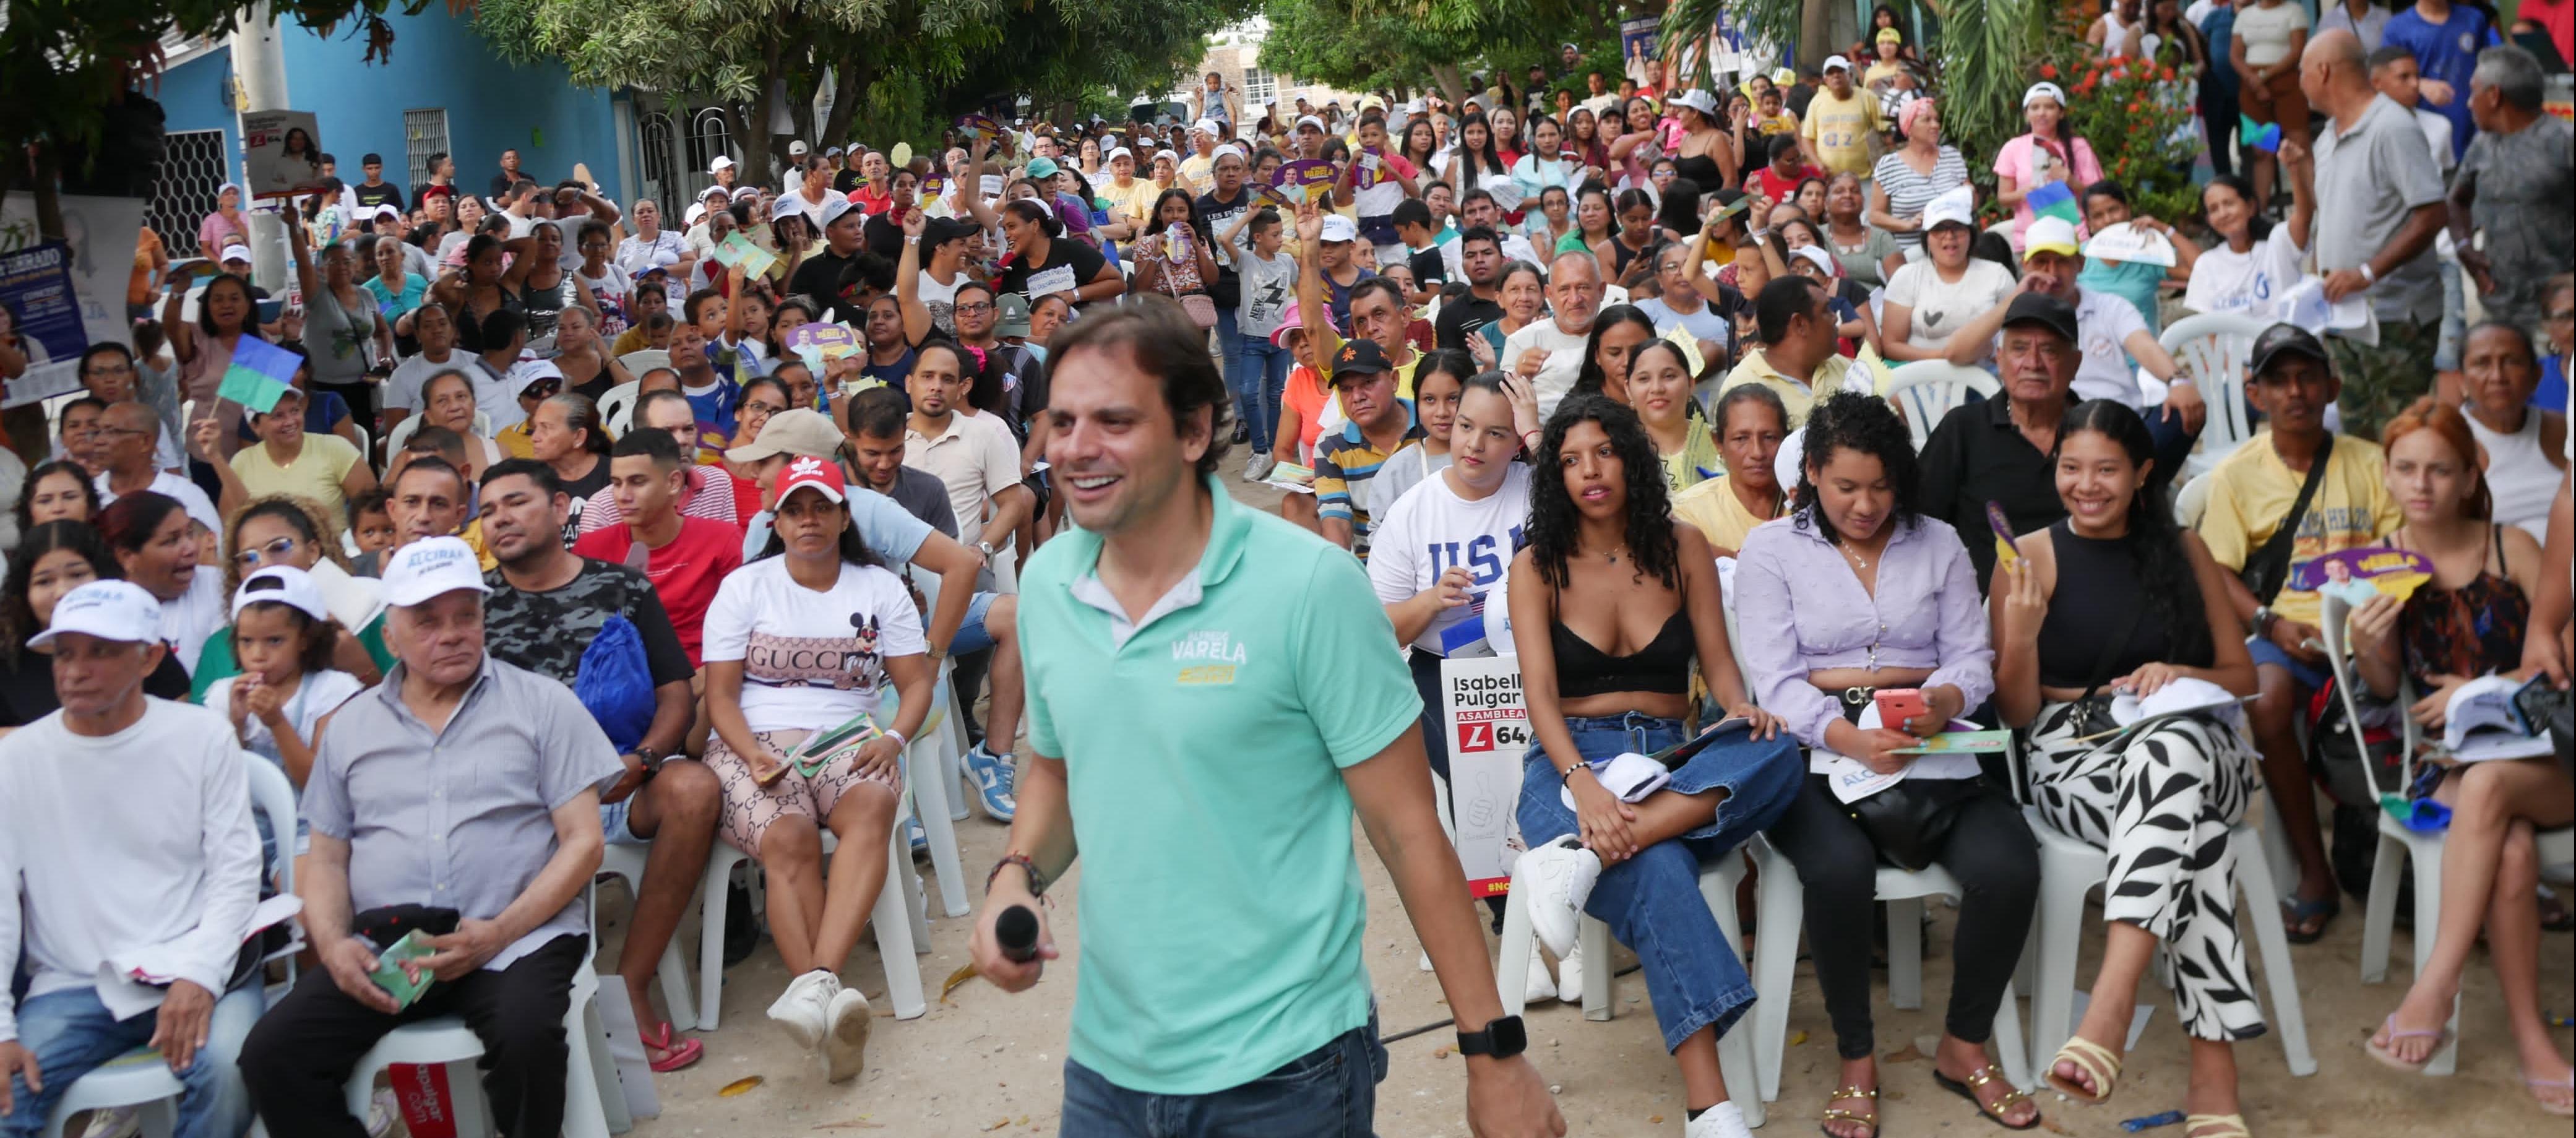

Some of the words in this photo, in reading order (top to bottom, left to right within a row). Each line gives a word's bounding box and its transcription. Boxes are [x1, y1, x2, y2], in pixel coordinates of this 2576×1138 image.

[1304, 168, 1335, 179] VARELA
[1207, 212, 1222, 221] LES
[1249, 298, 1264, 319] NEW
[788, 469, 824, 481] adidas
[751, 645, 845, 671] GUCCI
[1172, 640, 1247, 665] VARELA
[1455, 691, 1520, 709] Pulgar
[1458, 710, 1525, 721] ASAMBLEA
[1465, 725, 1487, 748] L
[1496, 726, 1527, 744] 64
